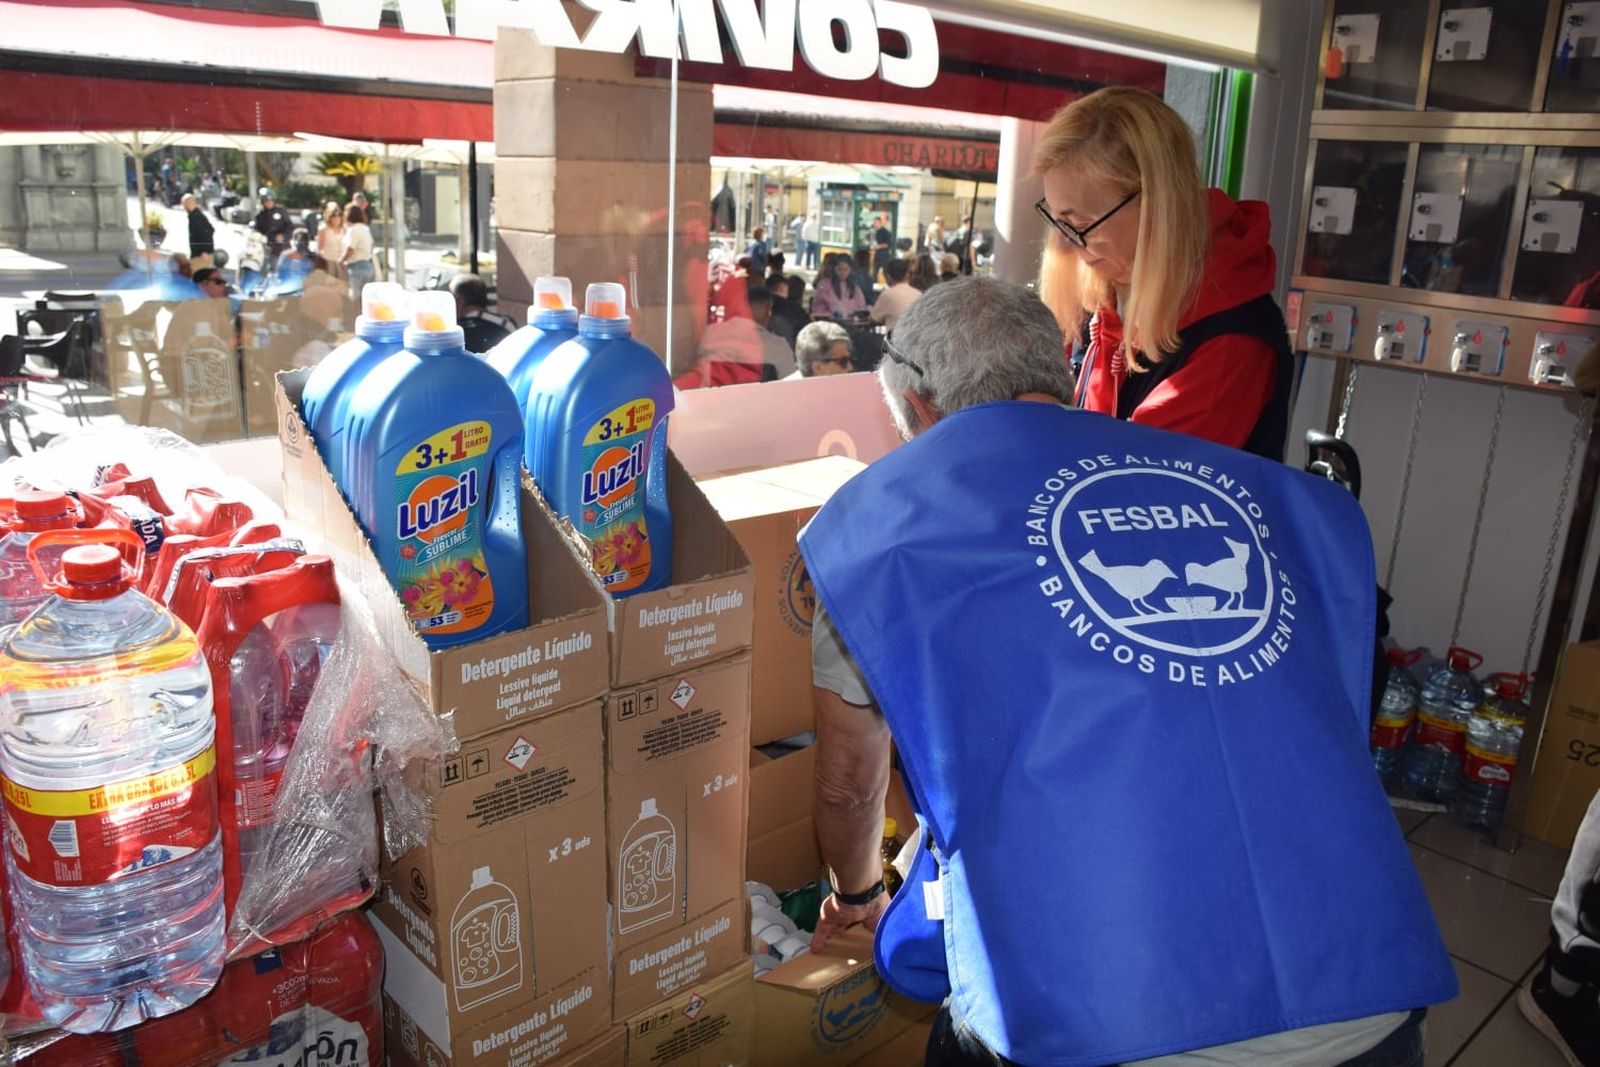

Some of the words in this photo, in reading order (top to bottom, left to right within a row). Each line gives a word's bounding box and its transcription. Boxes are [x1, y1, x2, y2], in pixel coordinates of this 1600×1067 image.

[464, 426, 484, 438] LITRO
[599, 406, 637, 440] 3+1
[415, 429, 467, 469] 3+1
[465, 436, 489, 449] GRATIS
[582, 441, 644, 505] Luzil
[397, 467, 479, 540] Luzil
[603, 496, 635, 522] SUBLIME
[1026, 468, 1077, 546] BANCOS
[1077, 454, 1117, 471] DE
[1125, 454, 1270, 539] ALIMENTOS
[1078, 503, 1229, 535] FESBAL
[426, 530, 467, 558] SUBLIME
[430, 616, 444, 627] 53
[639, 598, 703, 629] Detergente
[705, 590, 743, 615] Líquido
[1039, 575, 1156, 674] BANCOS
[1169, 661, 1207, 687] DE
[1218, 570, 1297, 686] ALIMENTOS
[462, 645, 541, 684] Detergente
[544, 631, 592, 661] Líquido
[496, 692, 522, 710] Liquid
[524, 680, 561, 703] detergent
[500, 677, 530, 694] Lessive
[532, 668, 558, 686] liquide
[561, 838, 572, 856] 3
[575, 836, 591, 850] uds
[629, 937, 692, 976] Detergente
[695, 916, 730, 945] Líquido
[472, 1012, 547, 1057] Detergente
[550, 985, 592, 1020] Líquido
